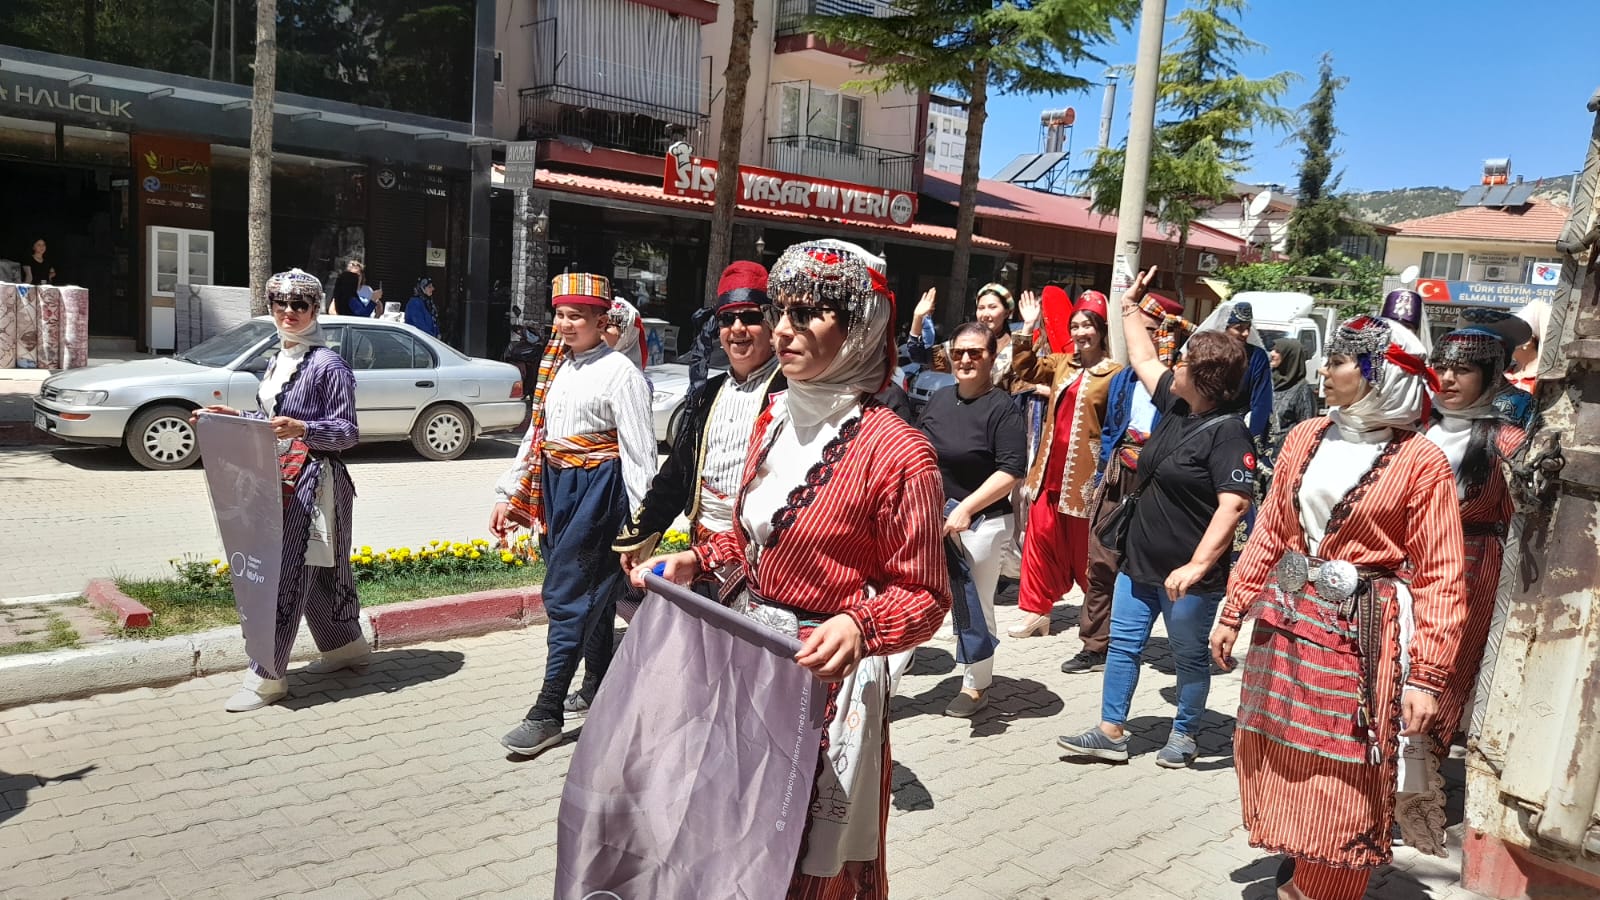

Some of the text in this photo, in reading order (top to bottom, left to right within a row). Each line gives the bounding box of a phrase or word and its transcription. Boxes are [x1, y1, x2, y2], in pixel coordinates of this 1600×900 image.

[15, 84, 133, 119] HALICILIK
[674, 158, 890, 218] ŞİŞ YAŞAR'IN YERİ
[1468, 285, 1496, 294] TÜRK
[1459, 293, 1496, 302] ELMALI
[1424, 304, 1466, 316] RESTAUR
